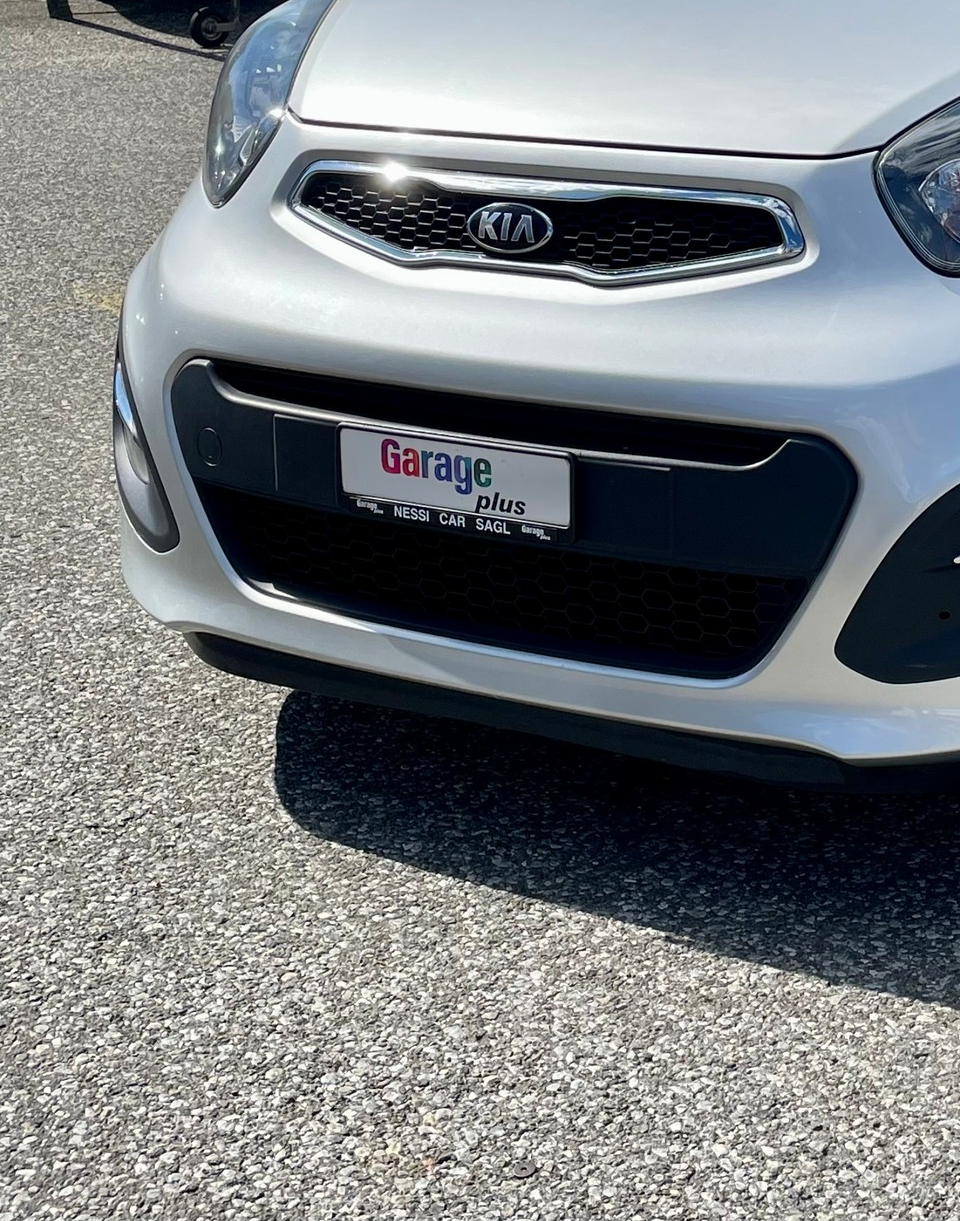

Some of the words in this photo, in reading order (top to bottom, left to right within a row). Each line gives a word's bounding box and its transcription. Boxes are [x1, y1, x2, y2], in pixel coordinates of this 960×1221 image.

[478, 211, 535, 243] KIA
[380, 438, 492, 495] Garage
[475, 492, 527, 516] plus
[394, 505, 430, 522] NESSI
[439, 512, 466, 528] CAR
[475, 518, 511, 535] SAGL
